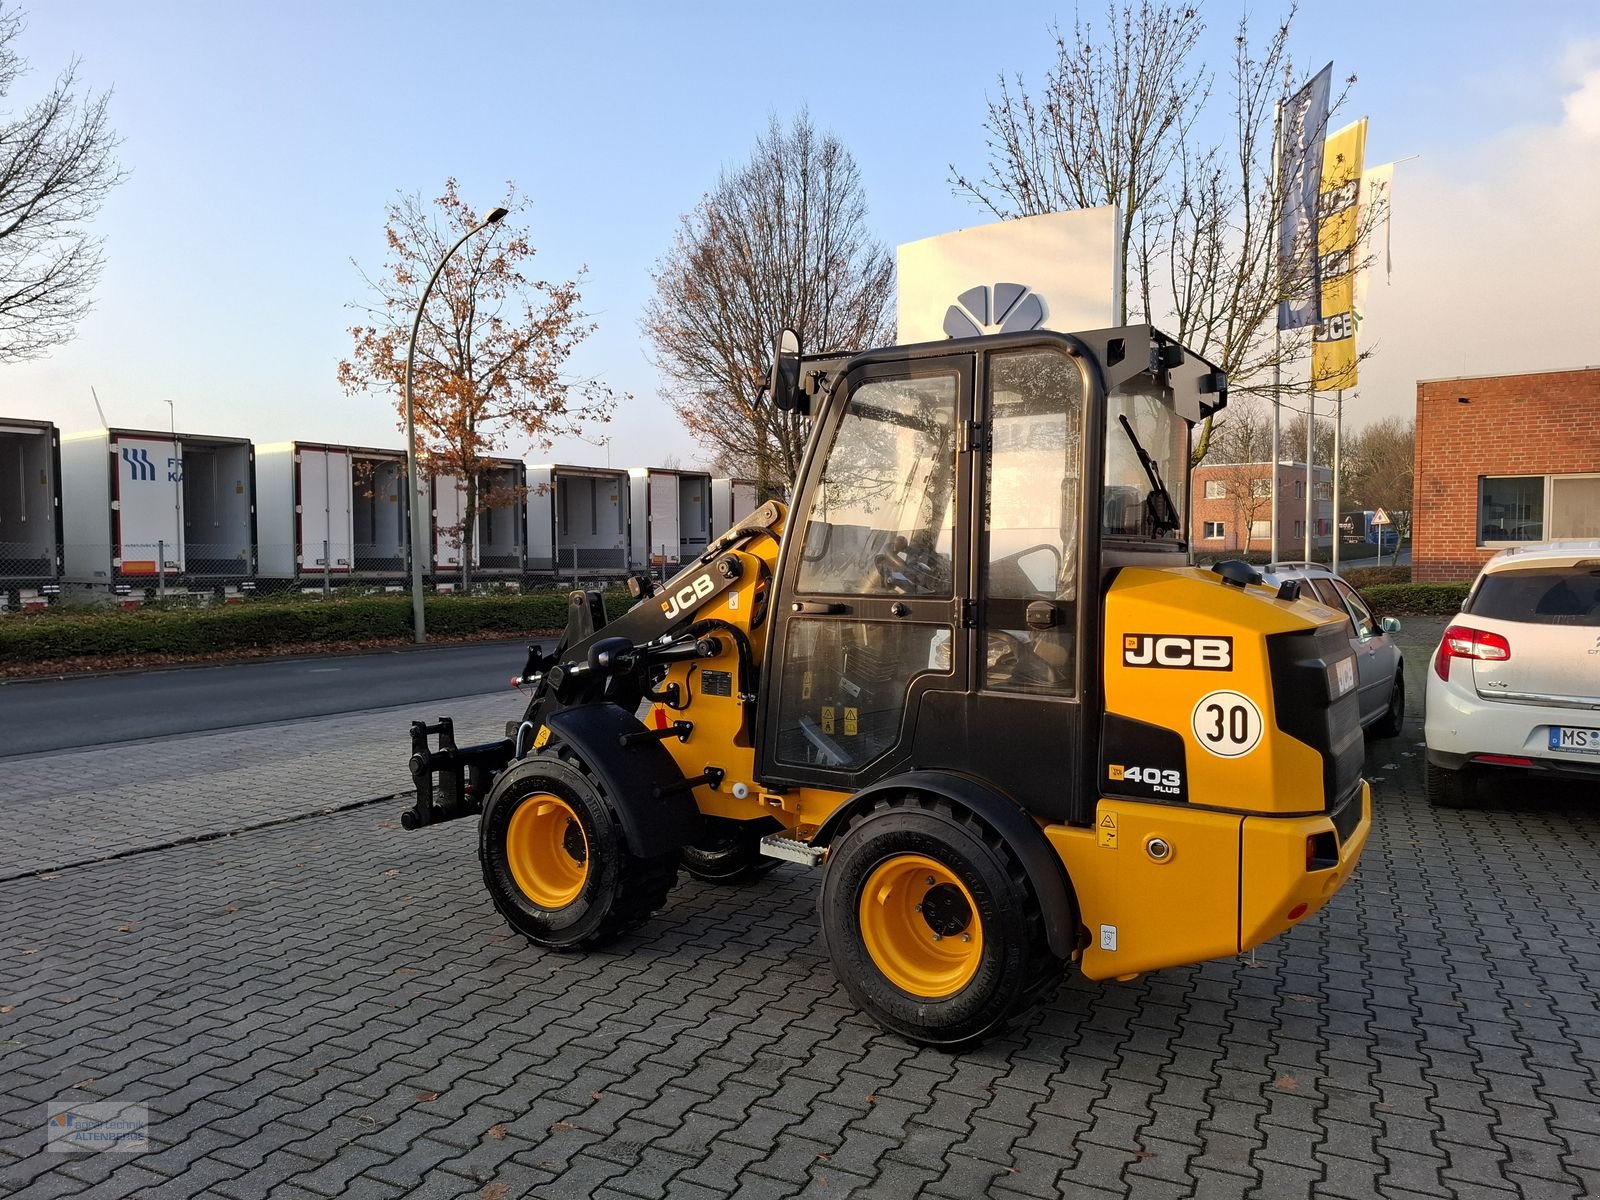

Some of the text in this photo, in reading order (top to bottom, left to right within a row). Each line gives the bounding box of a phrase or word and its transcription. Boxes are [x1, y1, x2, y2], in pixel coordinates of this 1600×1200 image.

[664, 573, 715, 620] JCB
[1125, 637, 1231, 668] JCB
[1205, 703, 1249, 745] 30
[1562, 729, 1587, 746] MS
[1123, 766, 1181, 787] 403
[1153, 785, 1181, 794] PLUS
